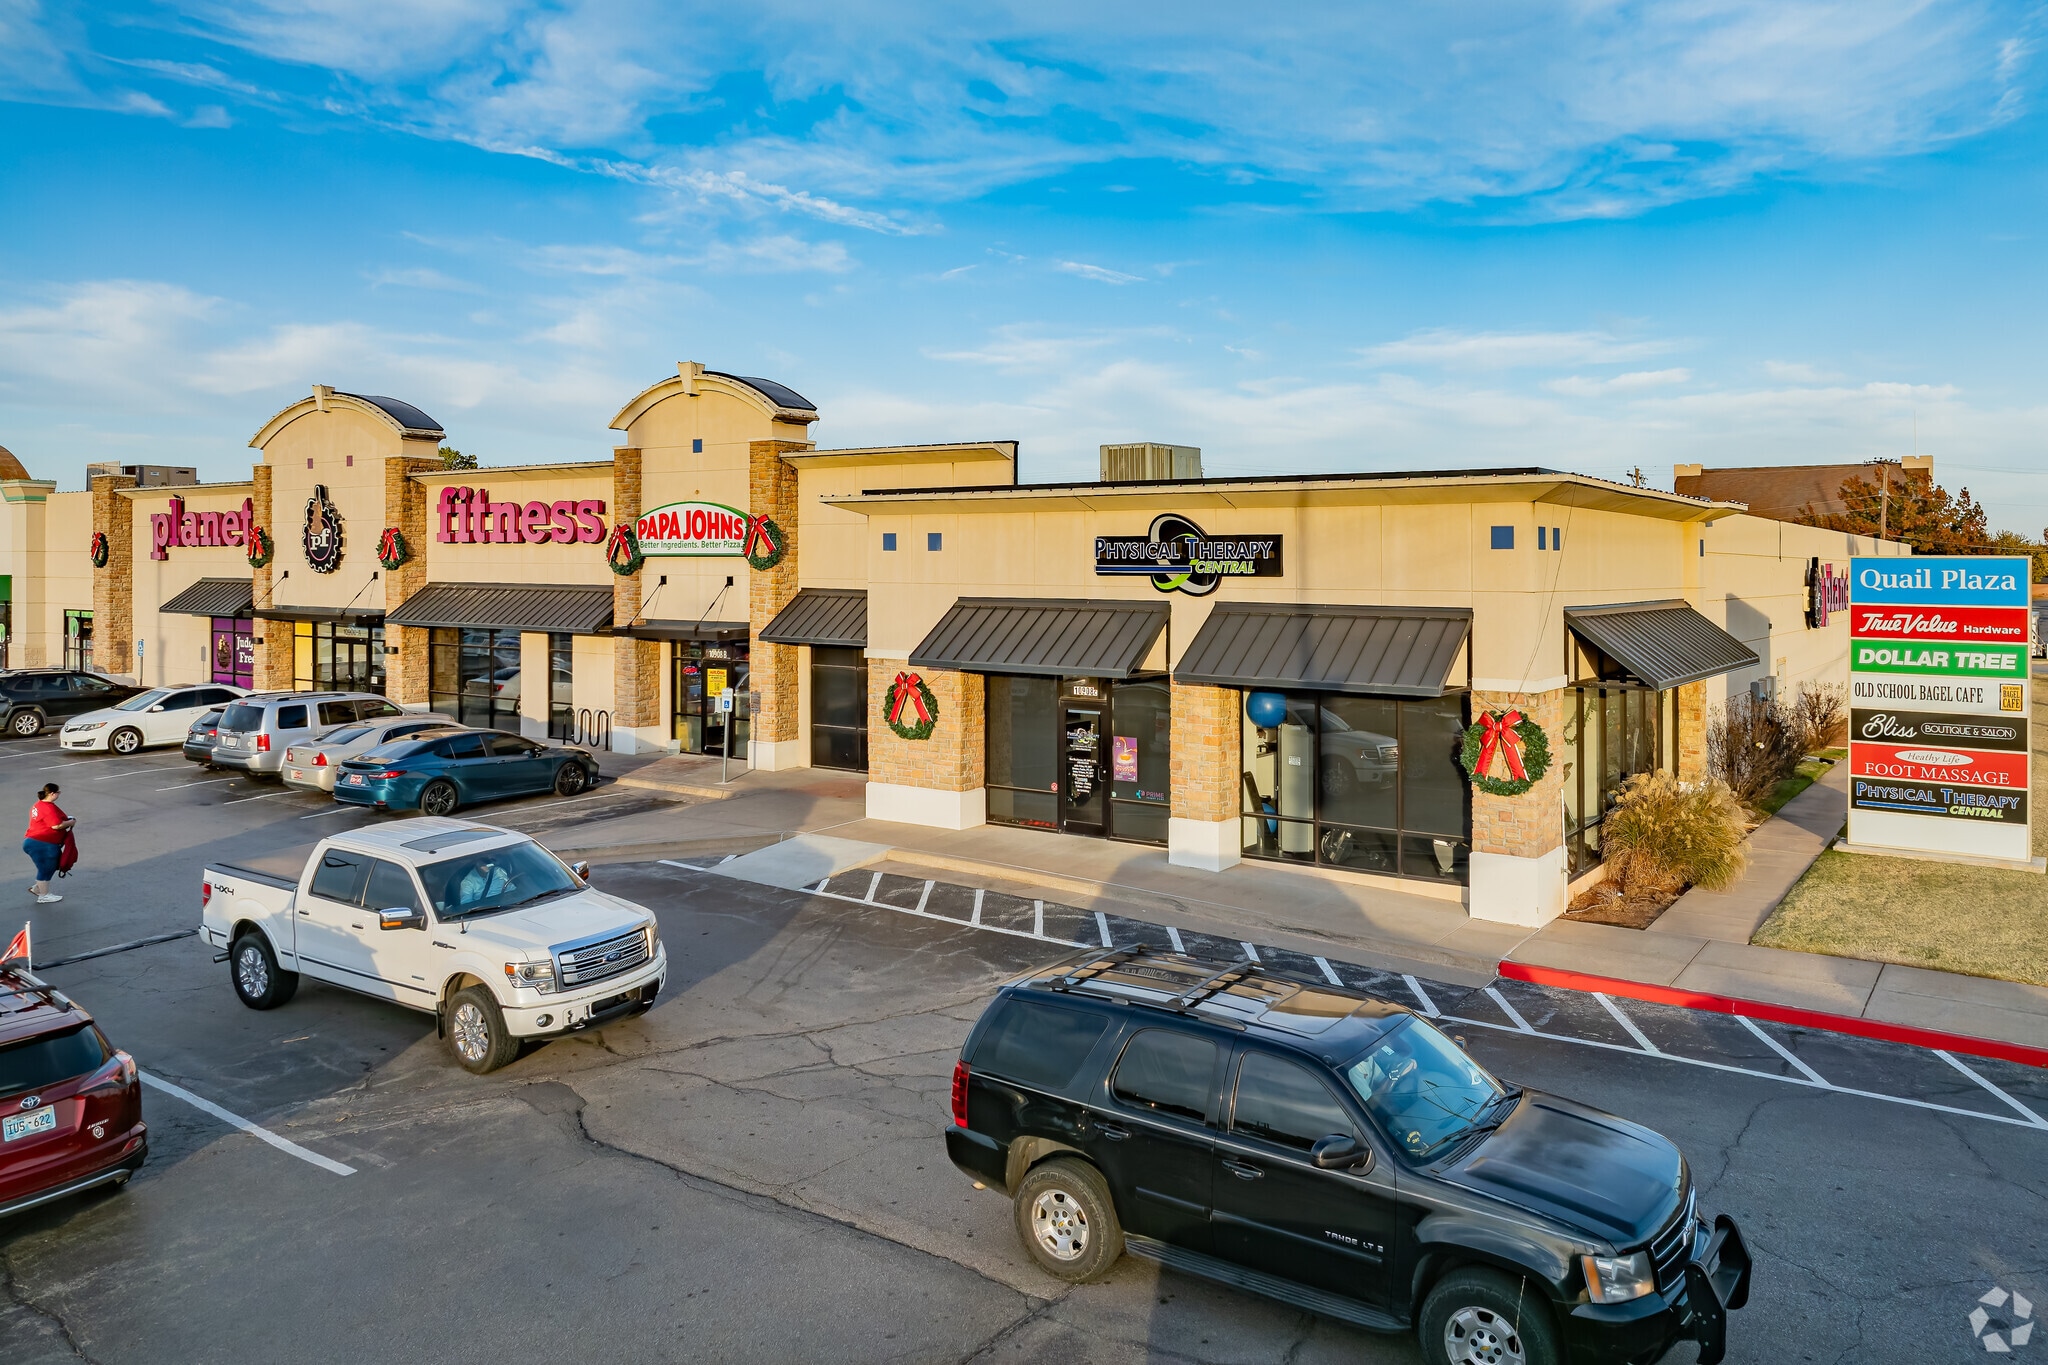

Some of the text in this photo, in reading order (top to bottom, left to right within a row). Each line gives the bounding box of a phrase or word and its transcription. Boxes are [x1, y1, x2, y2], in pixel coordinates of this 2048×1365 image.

[437, 486, 607, 543] fitness
[637, 509, 744, 541] PAPA JOHNS
[151, 497, 254, 561] planet
[310, 528, 331, 550] pf
[640, 540, 660, 549] Better
[661, 540, 700, 551] Ingredients.
[701, 540, 722, 549] Better
[1094, 537, 1273, 560] PHYSICAL THERAPY
[1195, 560, 1255, 574] CENTRAL
[1860, 568, 2017, 592] Quail Plaza
[1963, 624, 2021, 635] Hardware
[1858, 648, 2017, 670] DOLLAR TREE
[1854, 682, 1984, 703] OLD SCHOOL BAGEL CAFE
[2003, 690, 2020, 699] BAGEL
[2003, 698, 2021, 709] CAFE
[1862, 713, 2013, 738] Bliss BOUTIQUE & SALON
[1907, 752, 1961, 765] Heathy Life
[1865, 762, 2011, 785] FOOT MASSAGE
[1856, 781, 2020, 810] PHYSICAL THERAPY
[1949, 805, 2004, 819] CENTRAL
[1325, 1230, 1358, 1246] TAHOE
